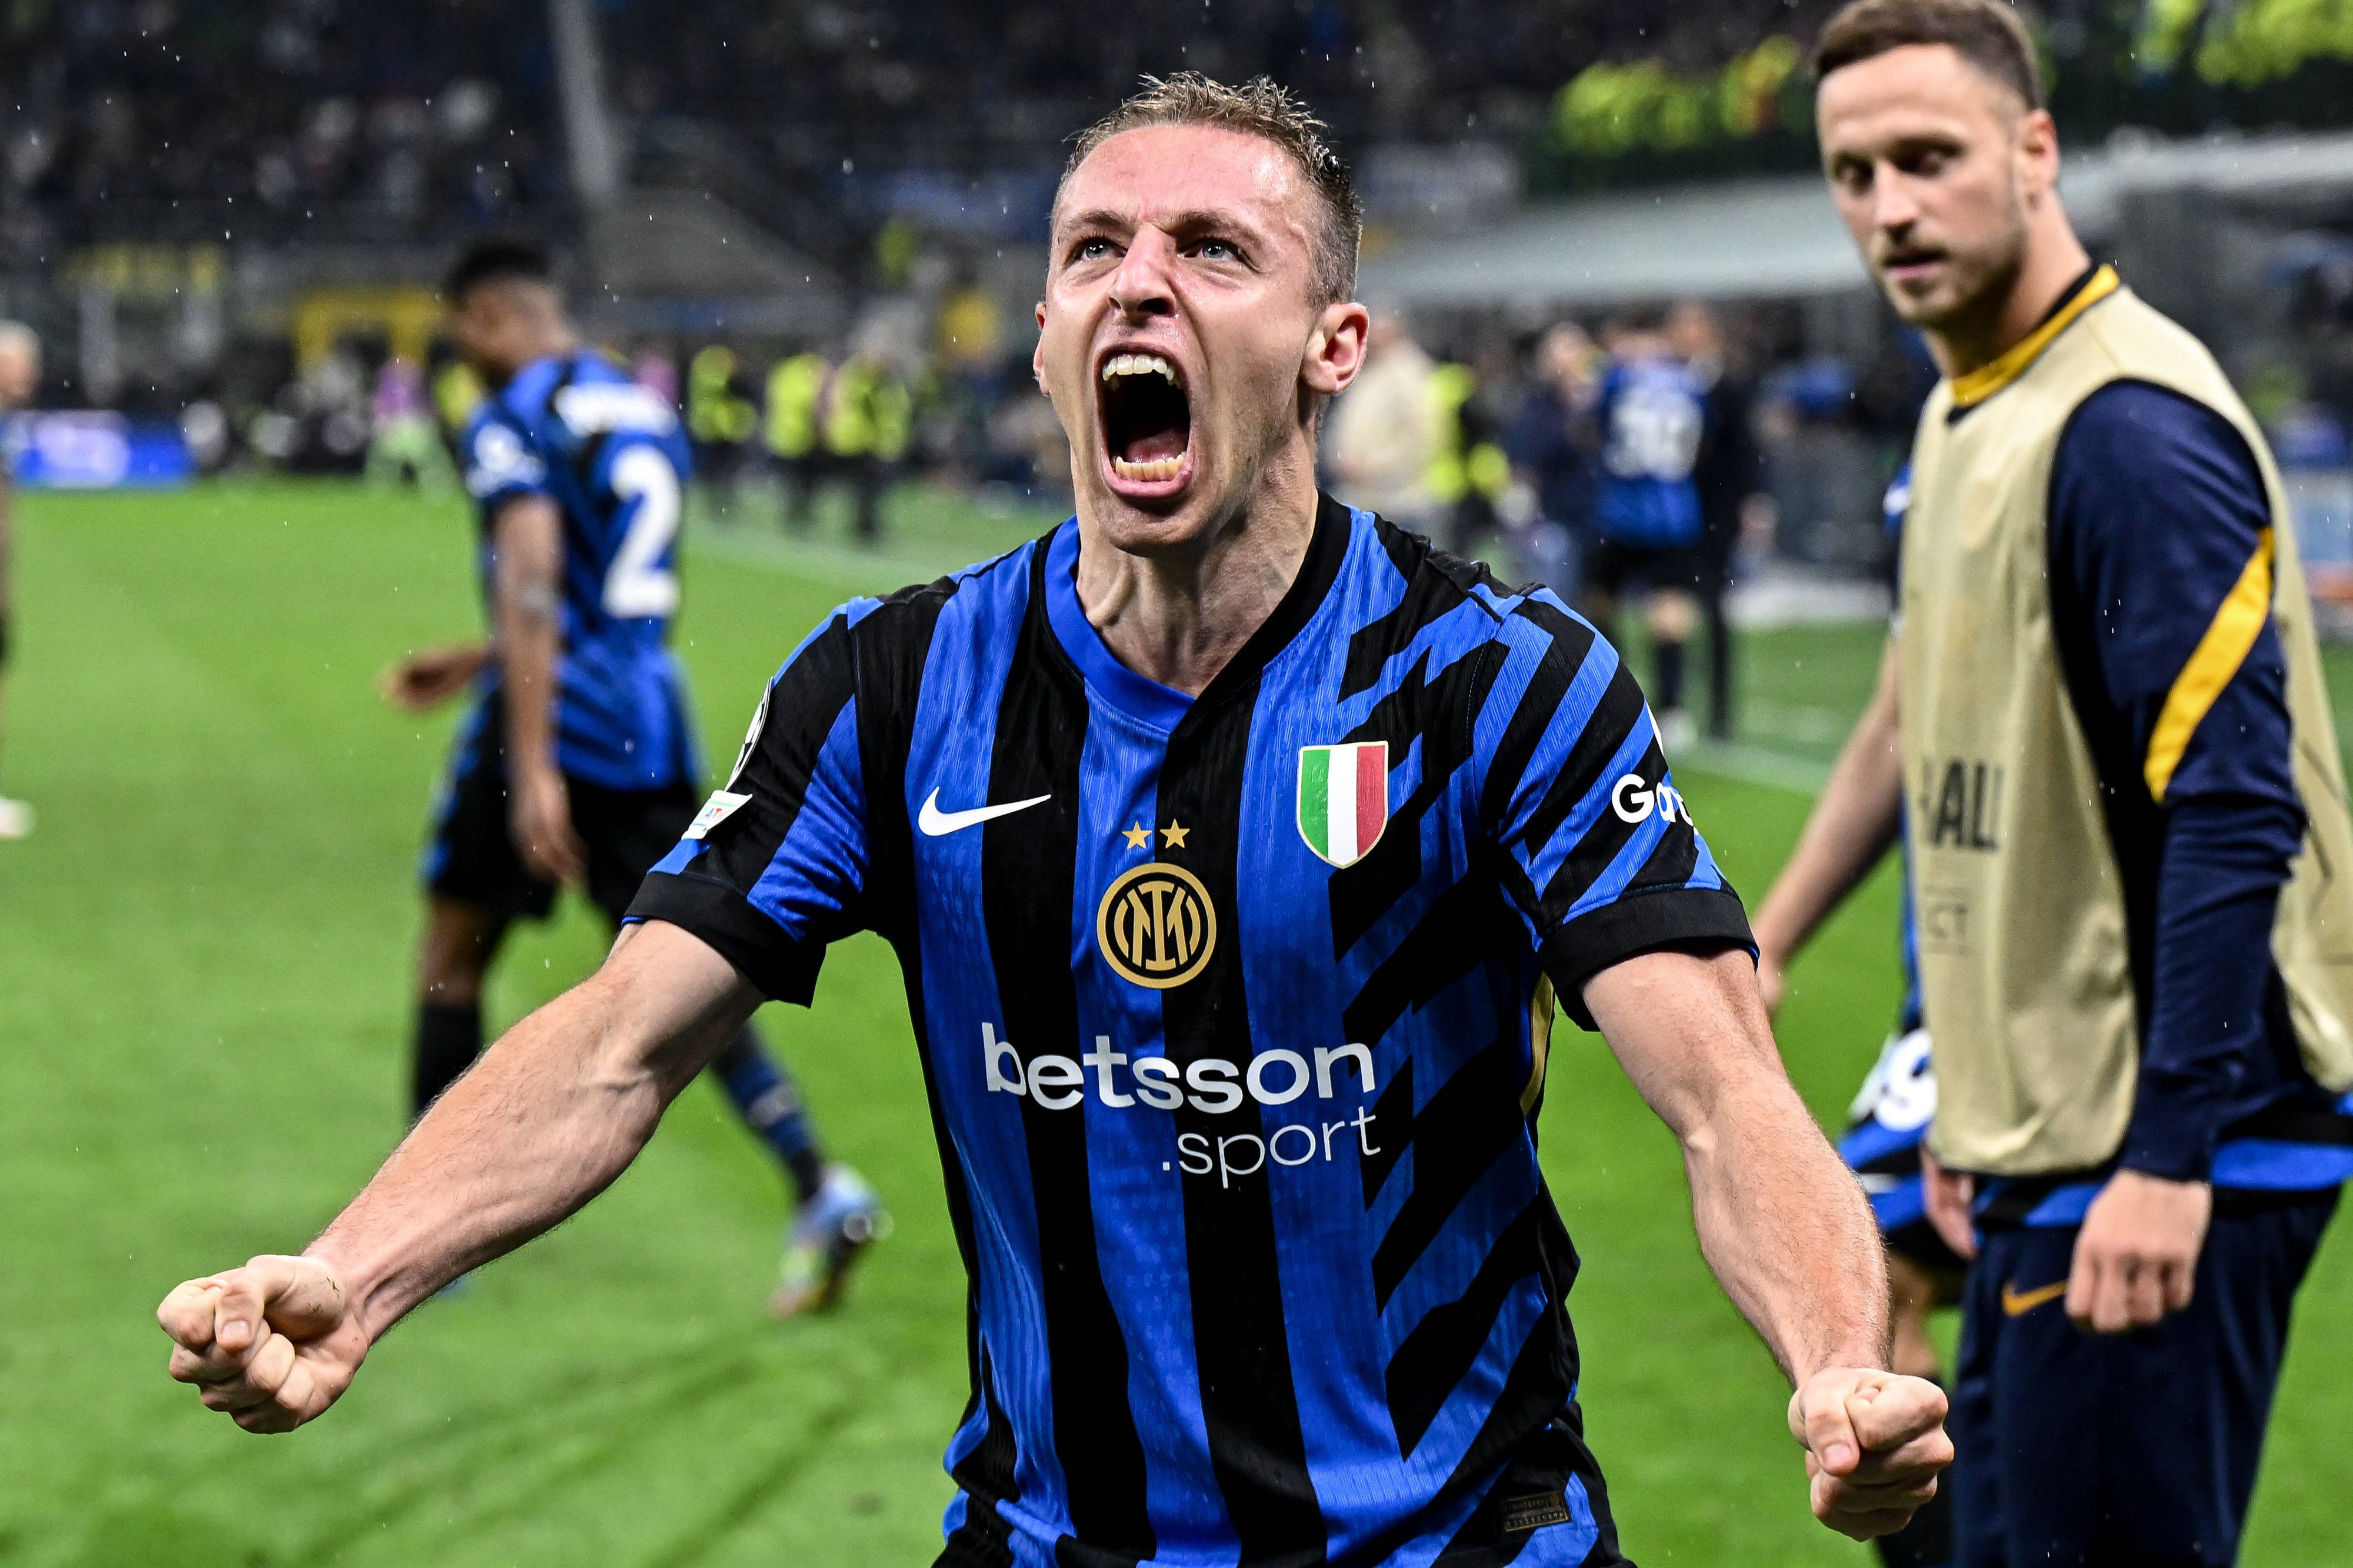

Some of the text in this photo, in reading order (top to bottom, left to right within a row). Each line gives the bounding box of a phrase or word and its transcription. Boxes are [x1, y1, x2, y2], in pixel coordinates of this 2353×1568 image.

[601, 442, 682, 620] 2
[981, 1022, 1376, 1114] betsson
[1162, 1106, 1381, 1189] .sport
